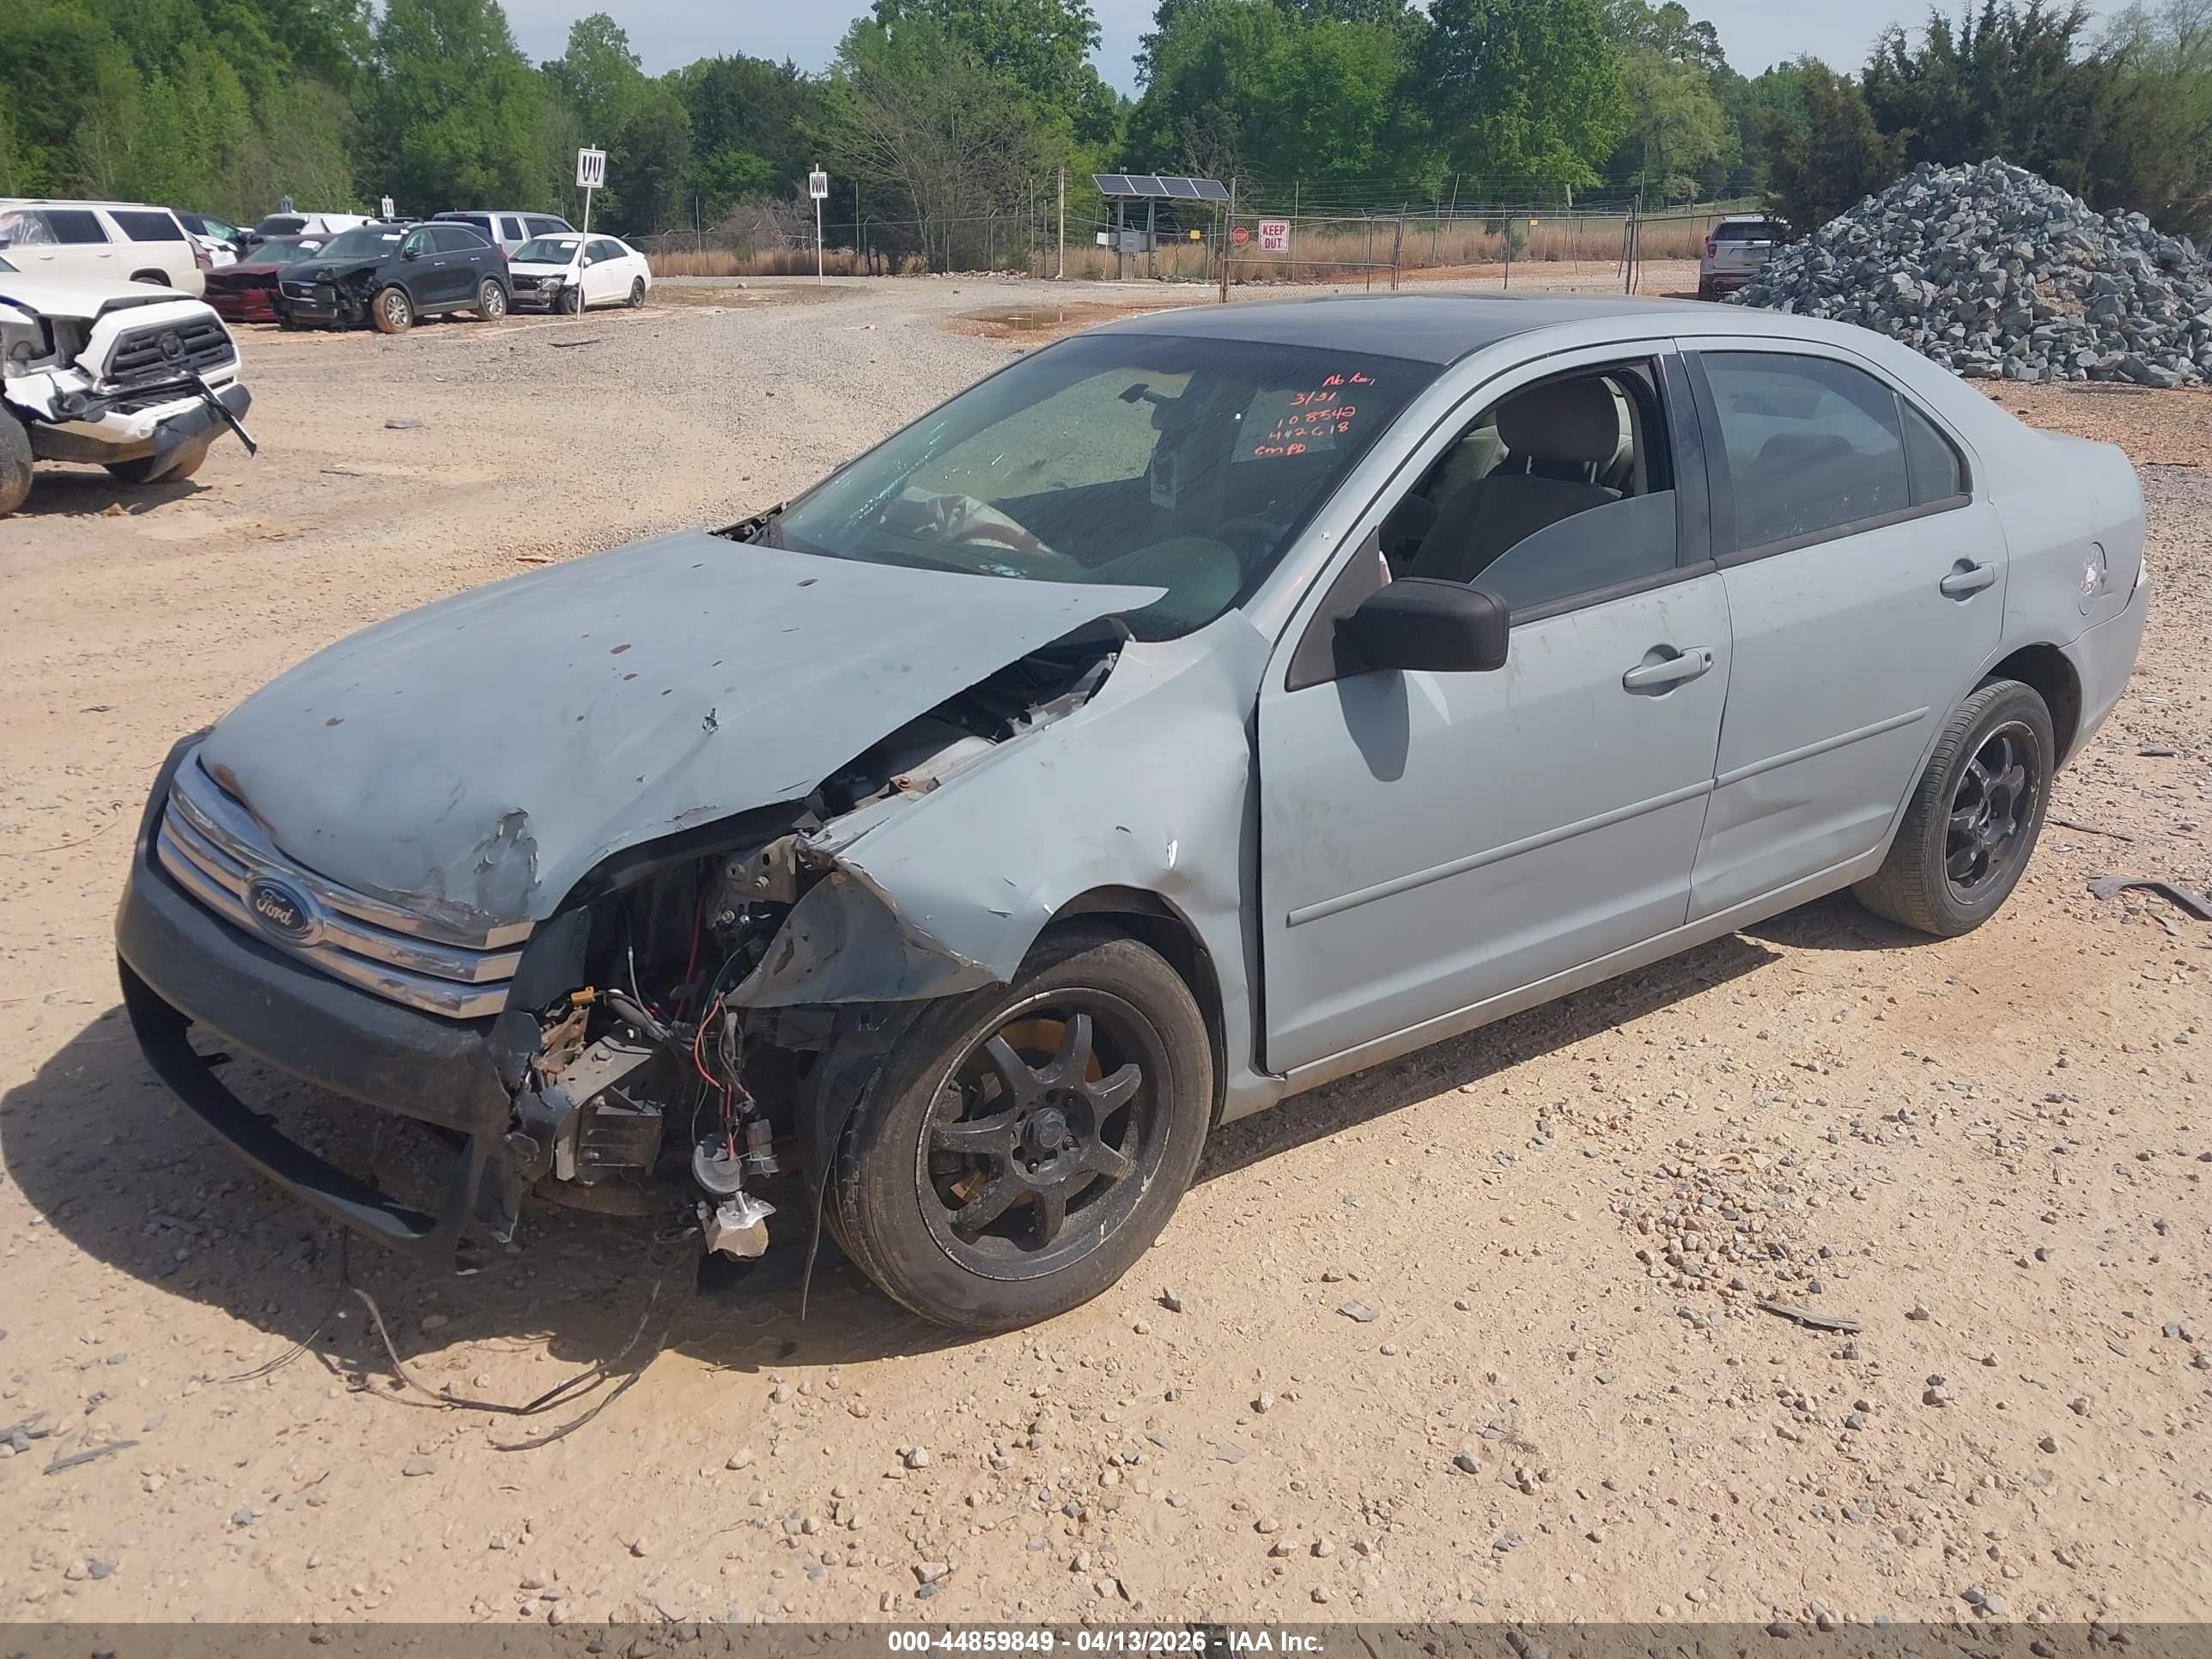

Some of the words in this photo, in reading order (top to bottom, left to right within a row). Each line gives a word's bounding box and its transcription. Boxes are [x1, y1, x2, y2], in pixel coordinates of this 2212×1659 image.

[1262, 224, 1285, 236] KEEP
[1264, 238, 1282, 249] OUT
[256, 888, 294, 926] Ford
